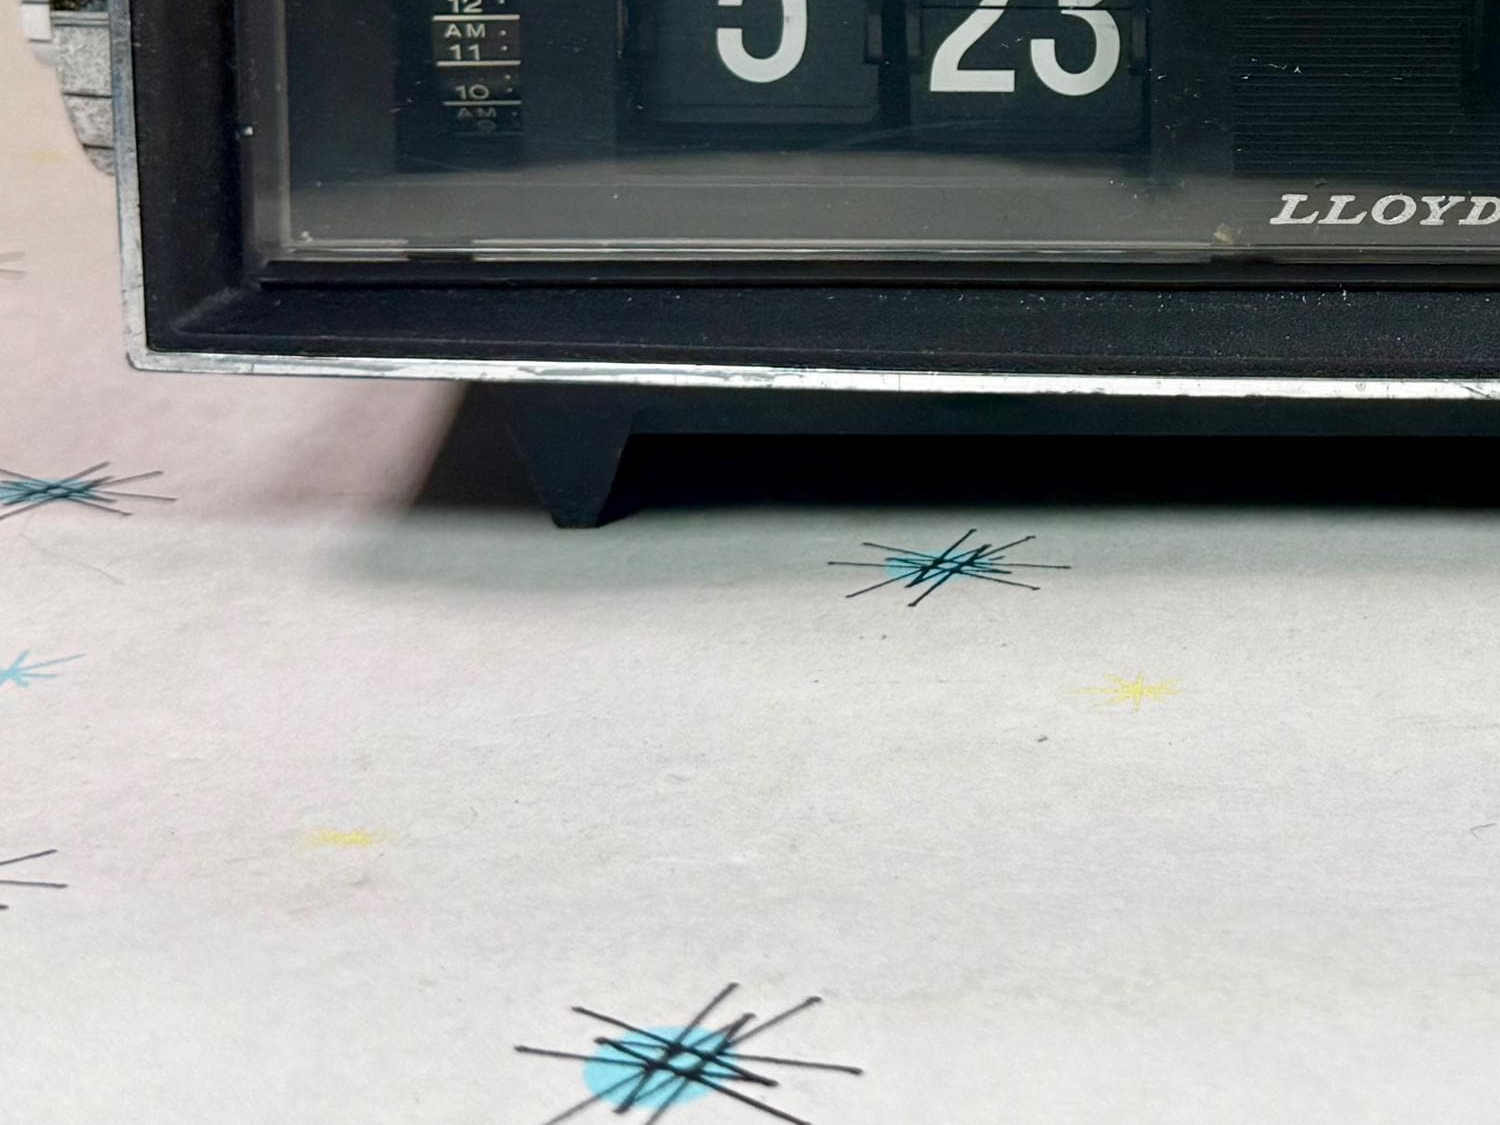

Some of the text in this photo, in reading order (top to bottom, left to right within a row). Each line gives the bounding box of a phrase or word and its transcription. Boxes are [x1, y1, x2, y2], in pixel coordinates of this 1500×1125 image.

[445, 23, 486, 38] AM
[450, 44, 481, 61] 11
[456, 84, 490, 100] 10
